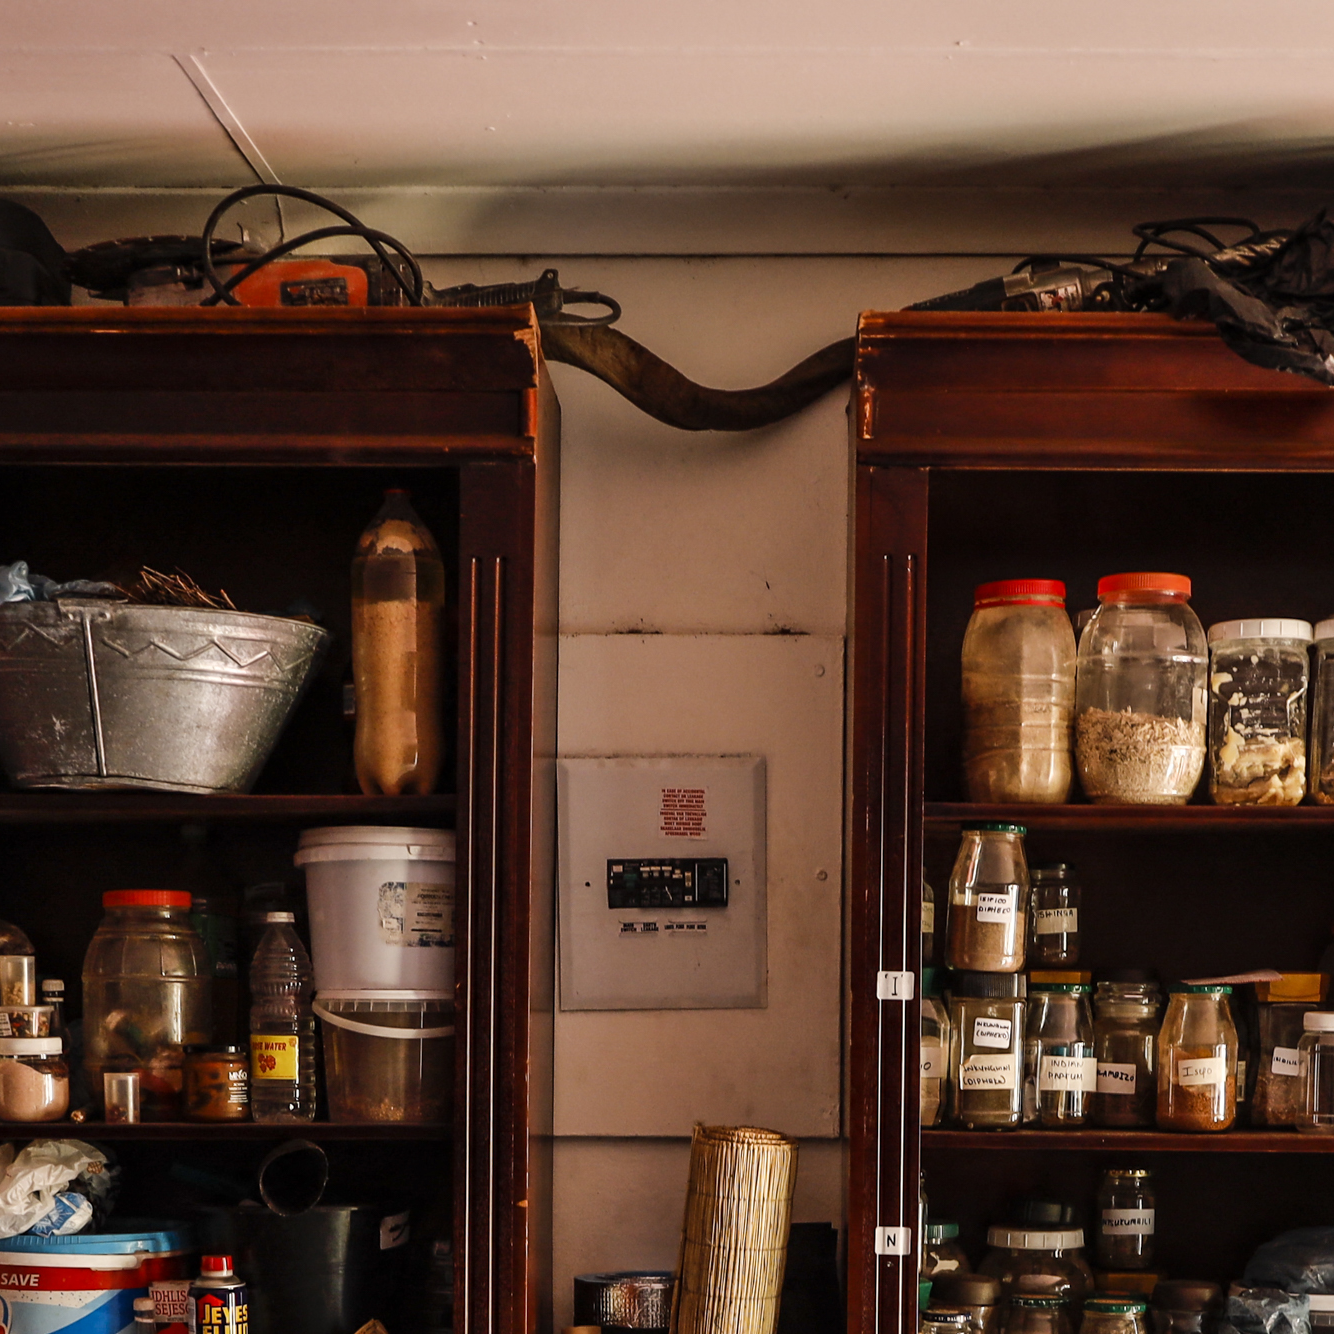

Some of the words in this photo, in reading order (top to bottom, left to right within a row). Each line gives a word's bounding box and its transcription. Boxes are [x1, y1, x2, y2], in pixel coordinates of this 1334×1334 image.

[265, 1042, 286, 1051] WATER
[886, 1232, 897, 1248] N
[1, 1274, 41, 1288] SAVE
[151, 1289, 188, 1302] IDHLIS
[202, 1302, 250, 1325] JEYES
